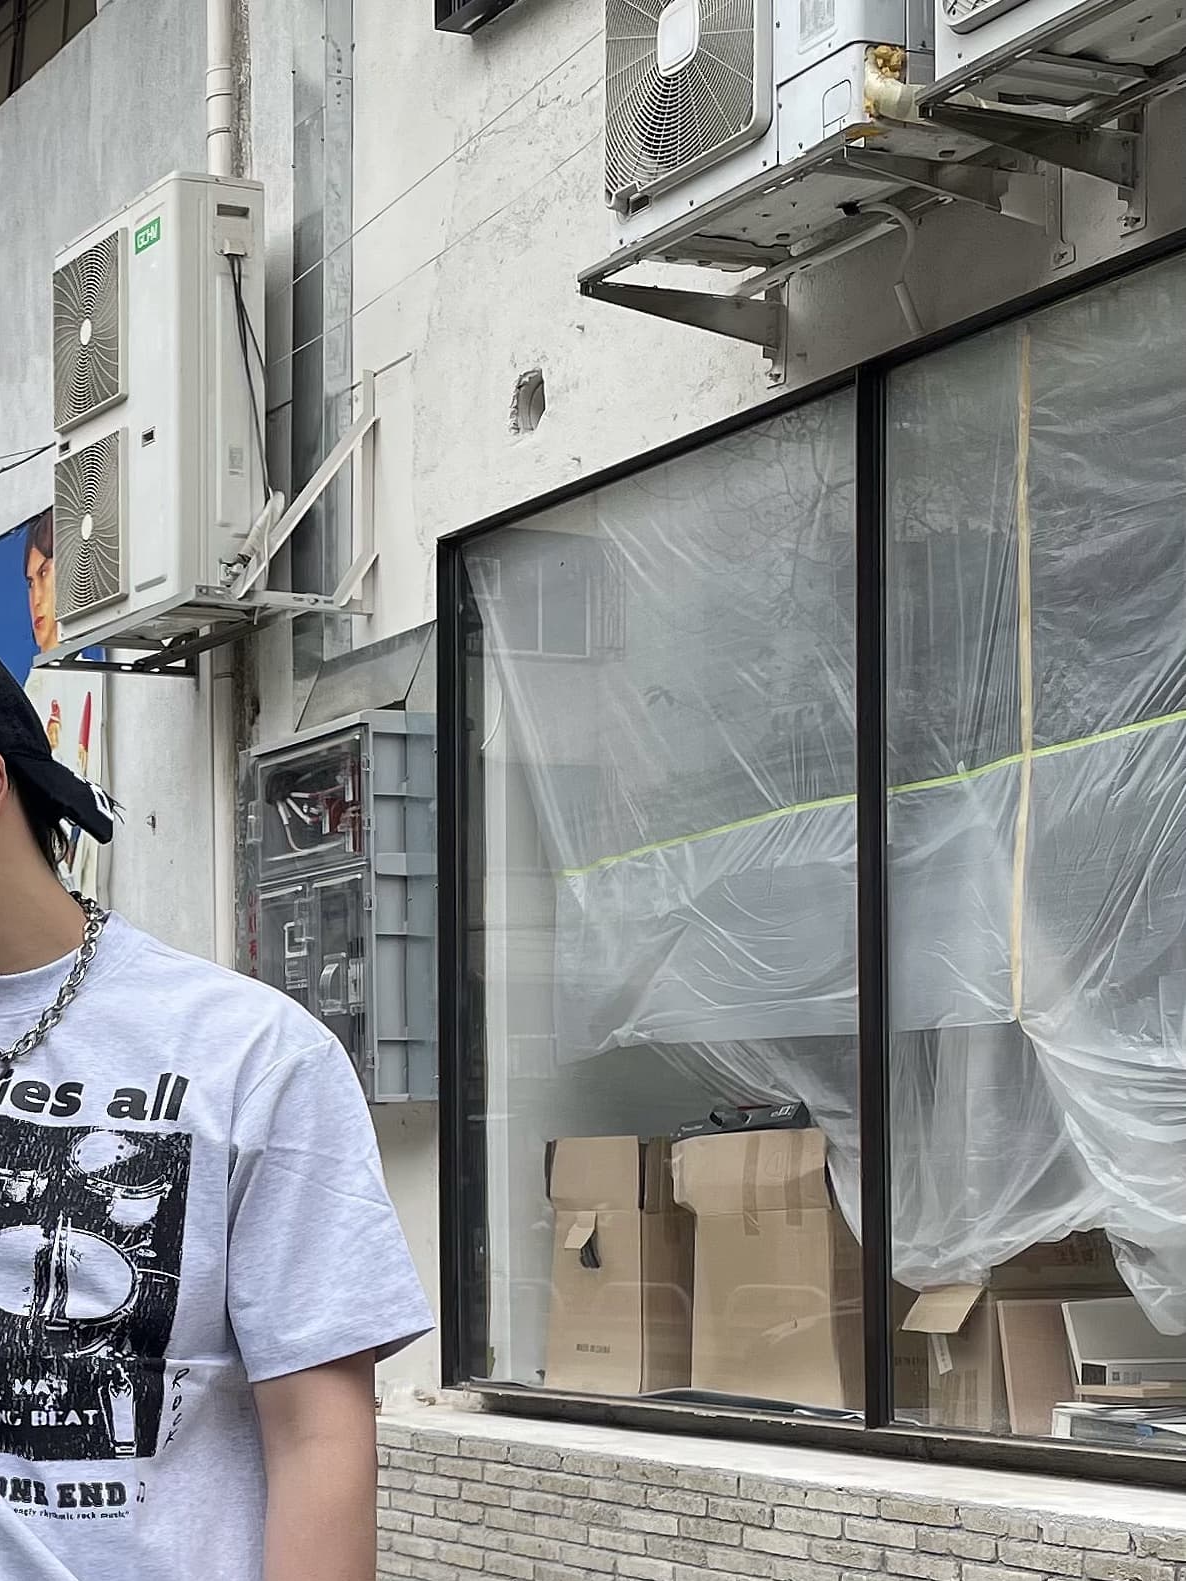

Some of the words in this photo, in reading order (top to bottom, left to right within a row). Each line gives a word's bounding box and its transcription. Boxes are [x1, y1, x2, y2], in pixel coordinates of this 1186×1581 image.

[106, 1072, 190, 1121] all
[30, 1409, 99, 1427] BEAT
[56, 1481, 128, 1509] END
